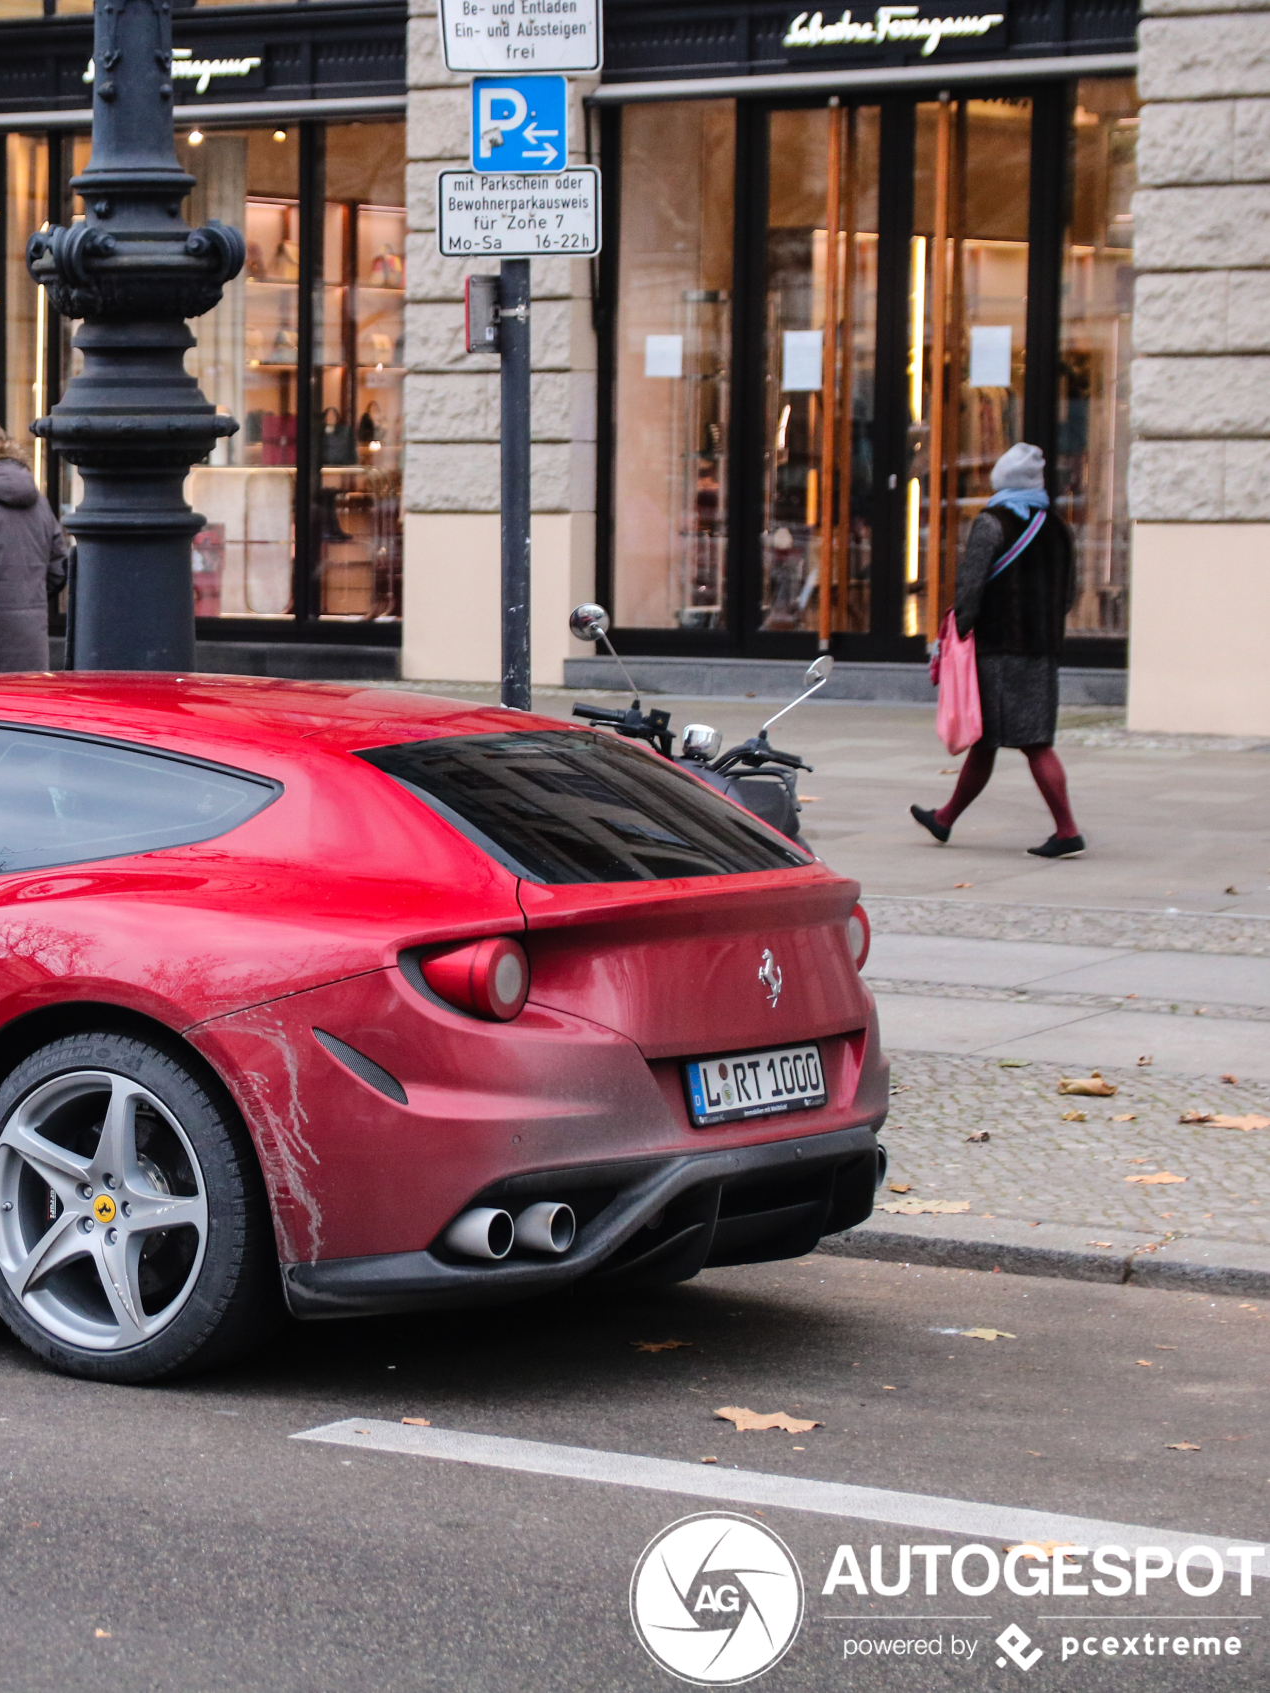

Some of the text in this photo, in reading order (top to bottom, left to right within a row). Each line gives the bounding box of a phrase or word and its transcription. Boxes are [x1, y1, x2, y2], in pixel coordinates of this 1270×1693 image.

[463, 0, 577, 15] Be- und Entladen
[455, 21, 587, 39] Ein- und Aussteigen
[875, 6, 1004, 57] Ferragamo
[506, 44, 535, 59] frei
[480, 88, 528, 158] P
[454, 175, 583, 191] mit Parkschein oder
[448, 194, 589, 212] Bewohnerparkausweis
[474, 214, 564, 230] für Zone 7
[449, 235, 502, 250] Mo-Sa
[27, 1046, 92, 1077] MICHELIN
[703, 1067, 721, 1108] L
[695, 1094, 701, 1106] D
